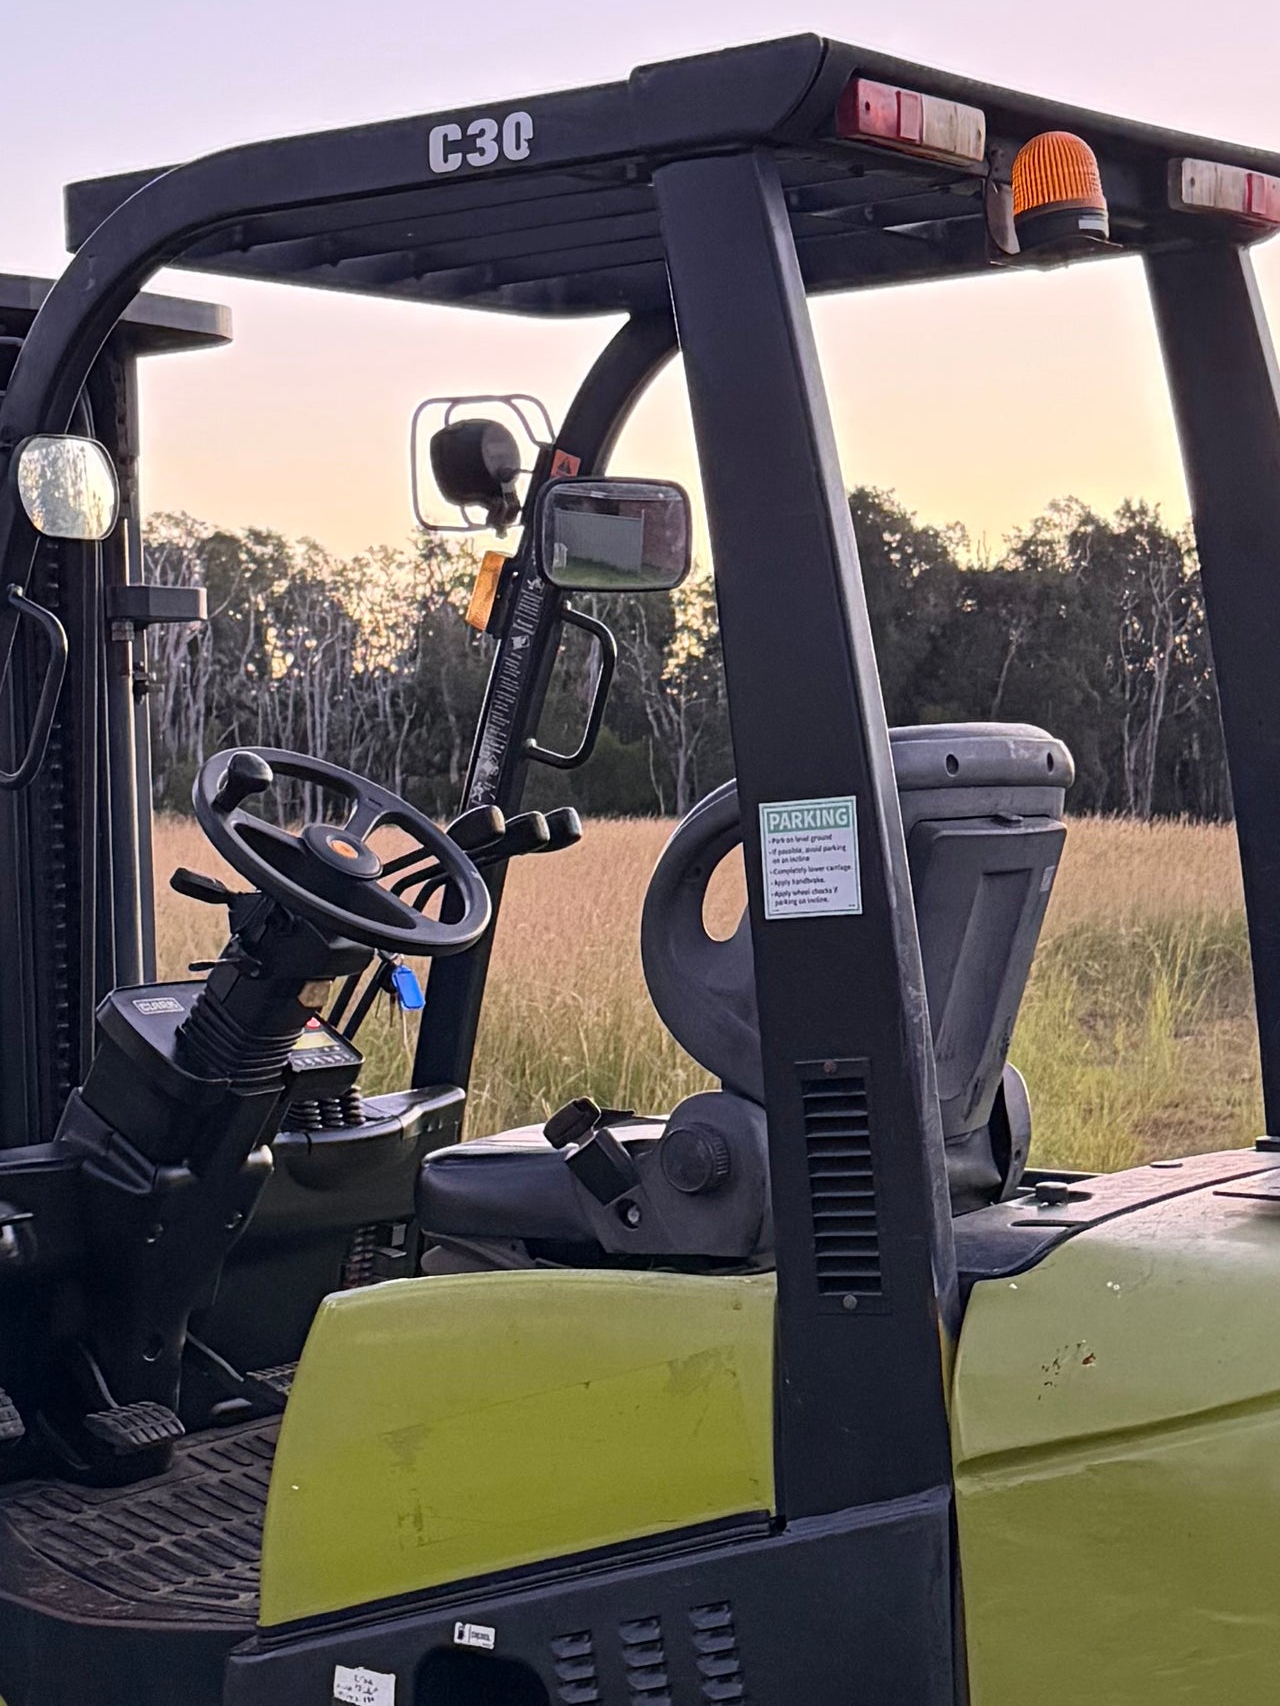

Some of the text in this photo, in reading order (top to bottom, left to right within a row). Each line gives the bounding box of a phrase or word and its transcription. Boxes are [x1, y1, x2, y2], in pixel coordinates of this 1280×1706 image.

[429, 111, 533, 174] C30
[769, 808, 848, 830] PARKING
[772, 837, 785, 845] Park
[810, 834, 832, 843] ground
[823, 844, 847, 853] parking
[773, 867, 807, 875] Completely
[774, 879, 790, 887] Apply
[774, 890, 791, 898] Apply
[775, 898, 797, 907] parking
